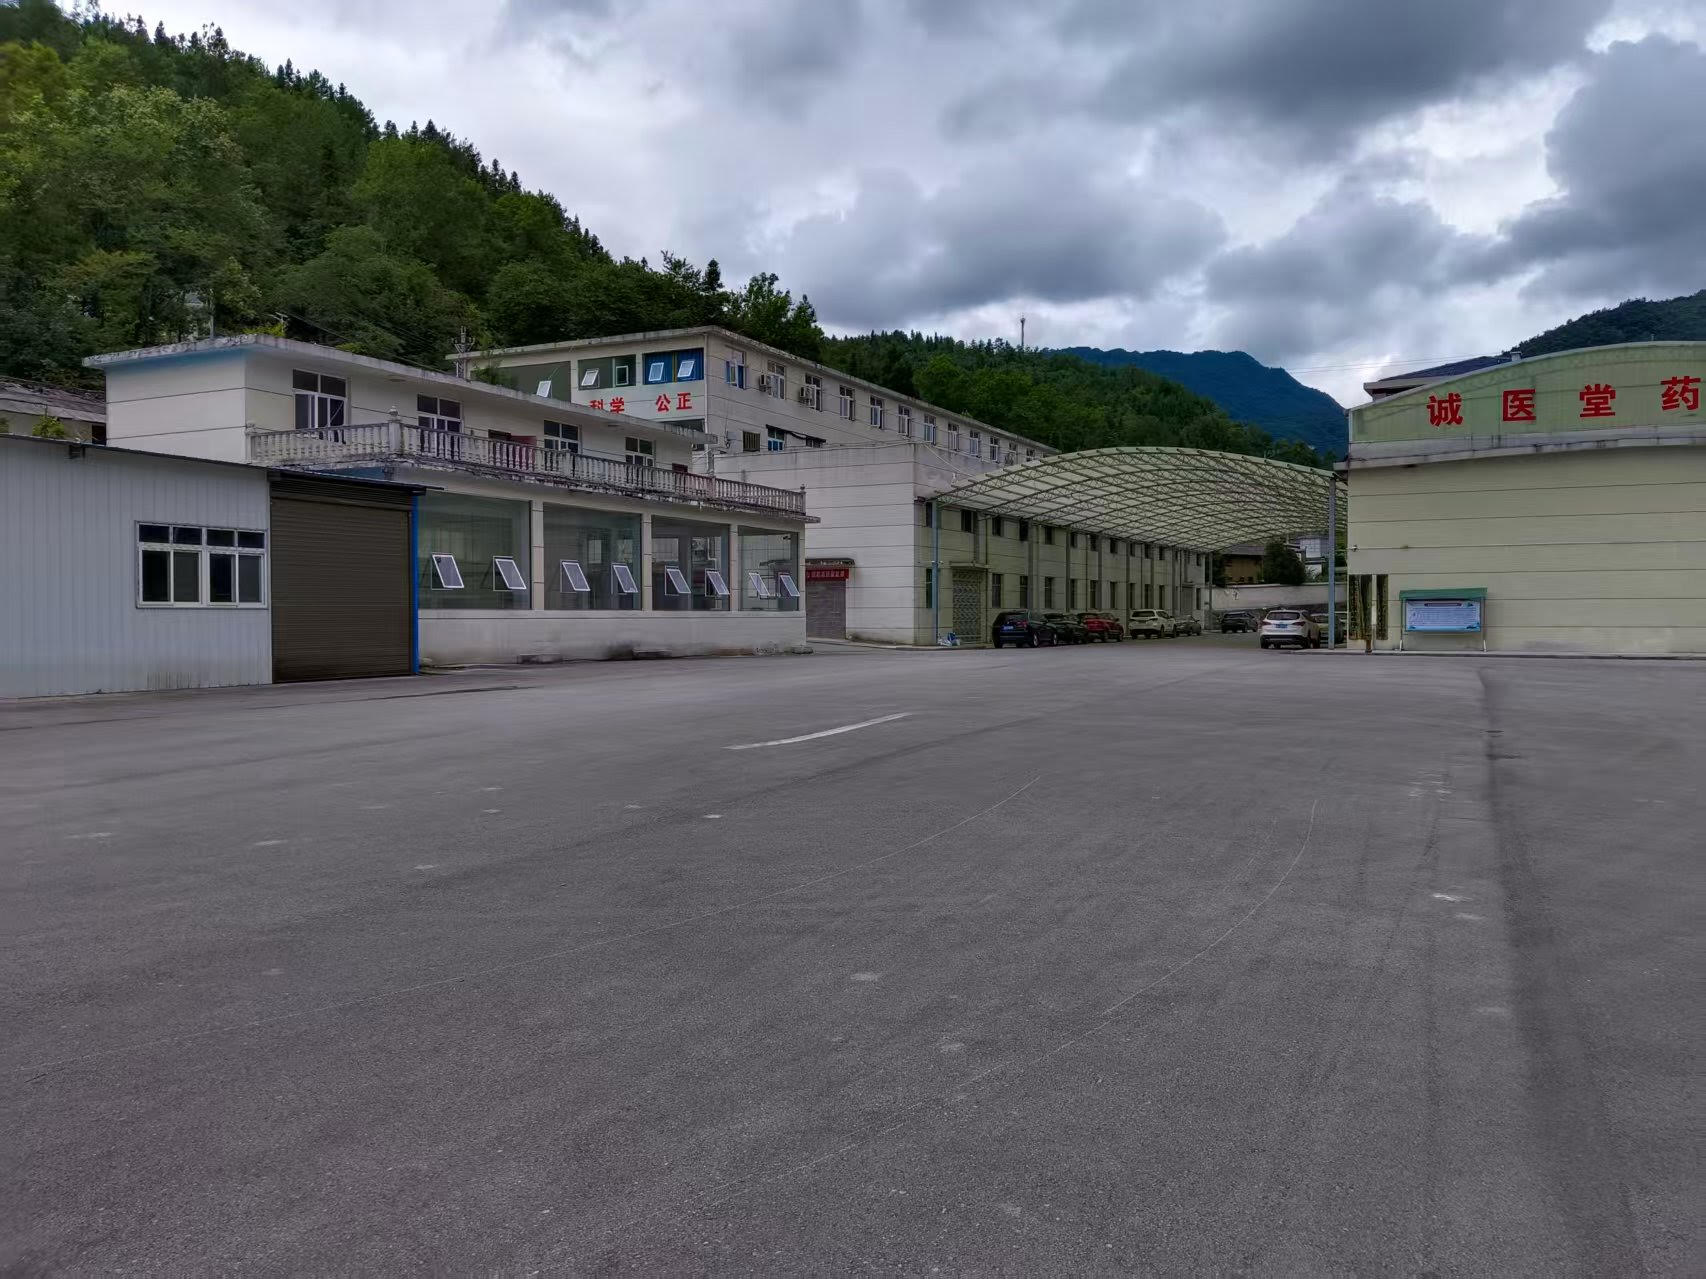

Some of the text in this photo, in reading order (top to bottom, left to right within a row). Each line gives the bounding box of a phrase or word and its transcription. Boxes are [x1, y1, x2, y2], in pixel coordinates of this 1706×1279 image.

[656, 392, 693, 412] 公正
[1427, 375, 1701, 427] 诚医堂药
